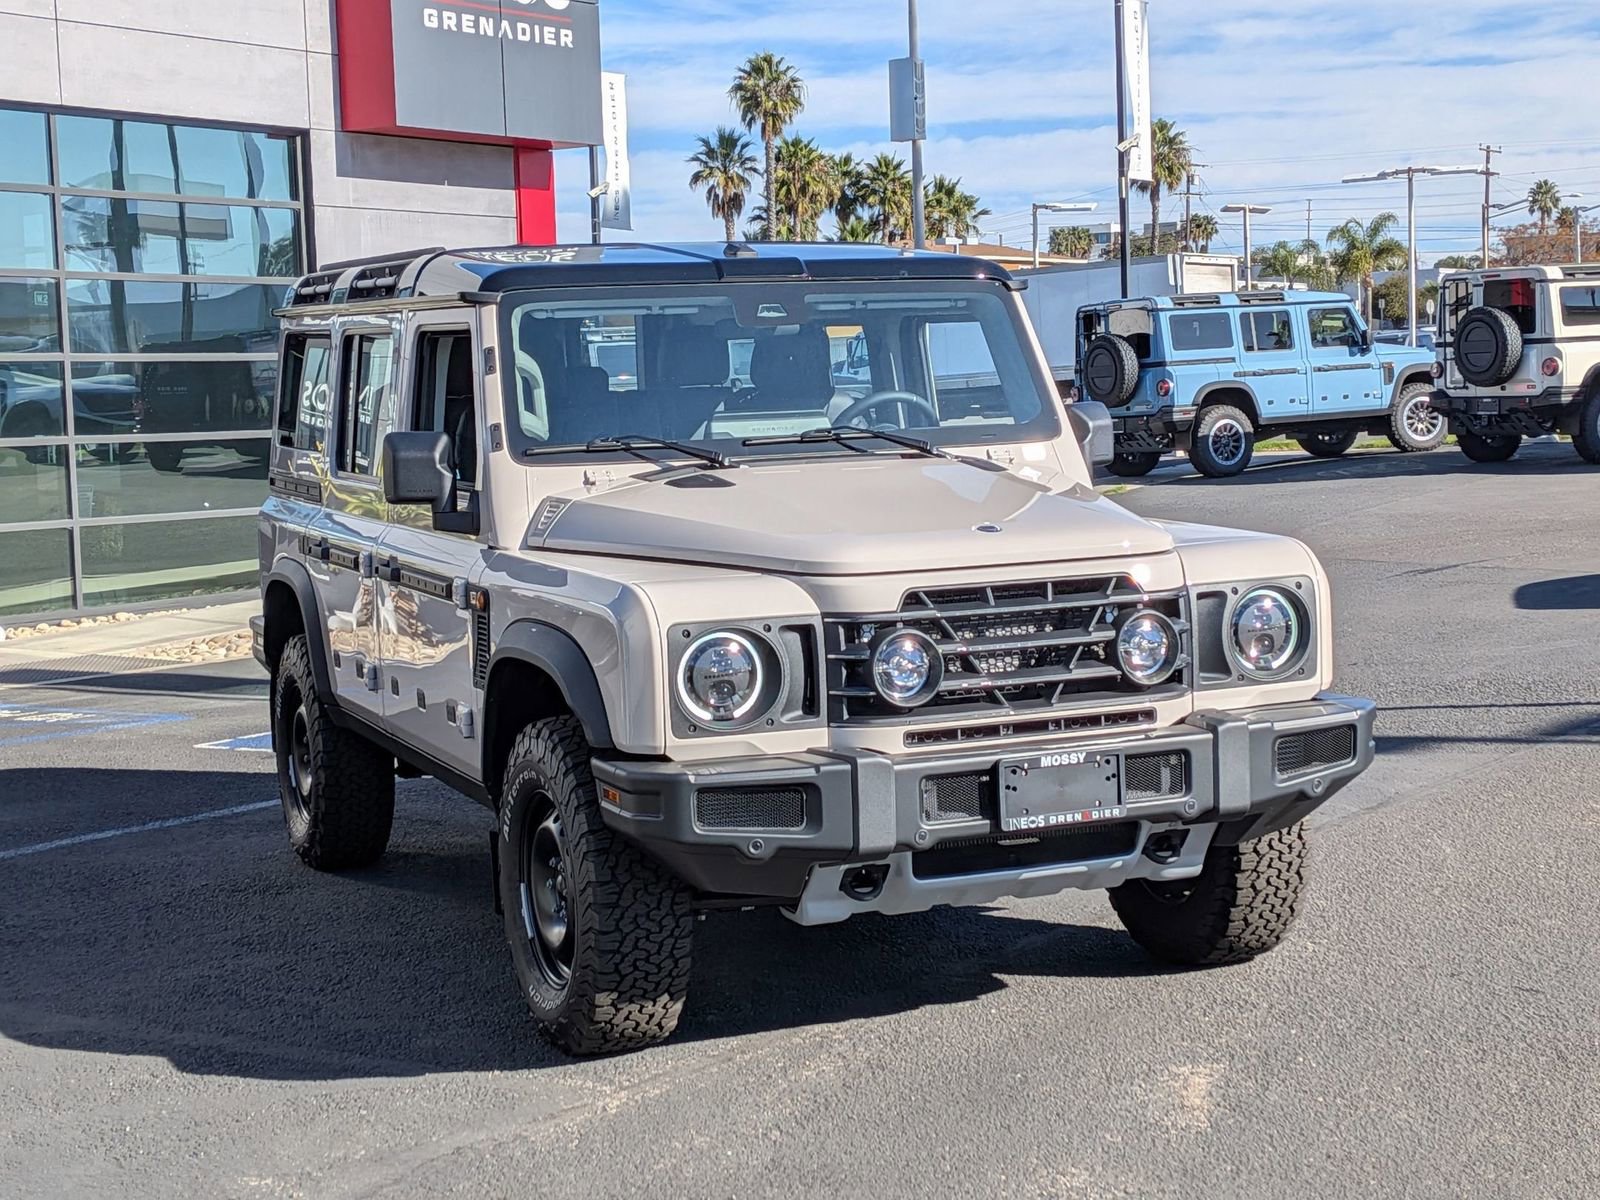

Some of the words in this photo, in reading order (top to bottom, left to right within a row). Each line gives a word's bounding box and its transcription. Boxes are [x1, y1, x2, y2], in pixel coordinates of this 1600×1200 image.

[423, 7, 574, 48] GRENADIER
[1040, 752, 1087, 767] MOSSY
[503, 768, 537, 843] All-Terrain
[1006, 814, 1045, 831] INEOS
[1049, 808, 1120, 825] GRENADIER
